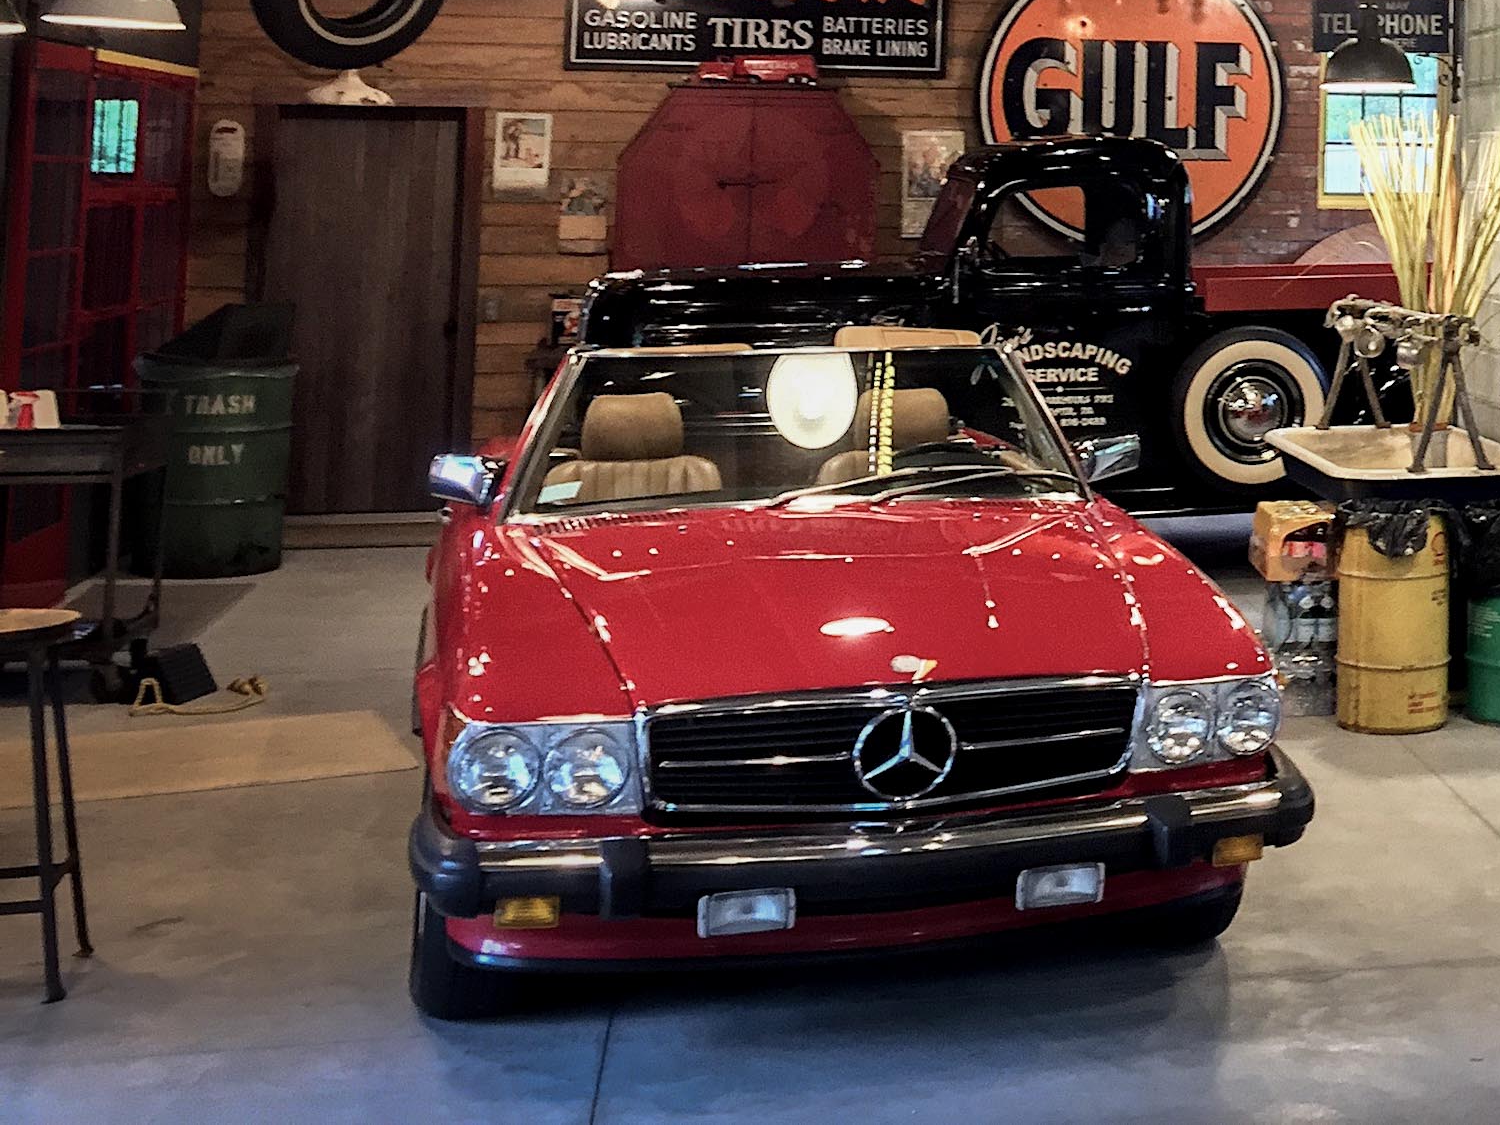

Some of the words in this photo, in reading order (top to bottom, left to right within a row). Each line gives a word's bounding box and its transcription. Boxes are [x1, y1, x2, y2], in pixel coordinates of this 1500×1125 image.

[583, 9, 698, 30] GASOLINE
[823, 15, 929, 36] BATTERIES
[1319, 13, 1444, 36] TELPHONE
[583, 32, 696, 52] LUBRICANTS
[706, 17, 814, 50] TIRES
[822, 39, 871, 56] BRAKE
[876, 41, 929, 58] LINING
[1003, 37, 1253, 161] GULF
[1014, 341, 1132, 375] NDSCAPING
[184, 393, 256, 416] TRASH
[187, 443, 243, 467] ONLY
